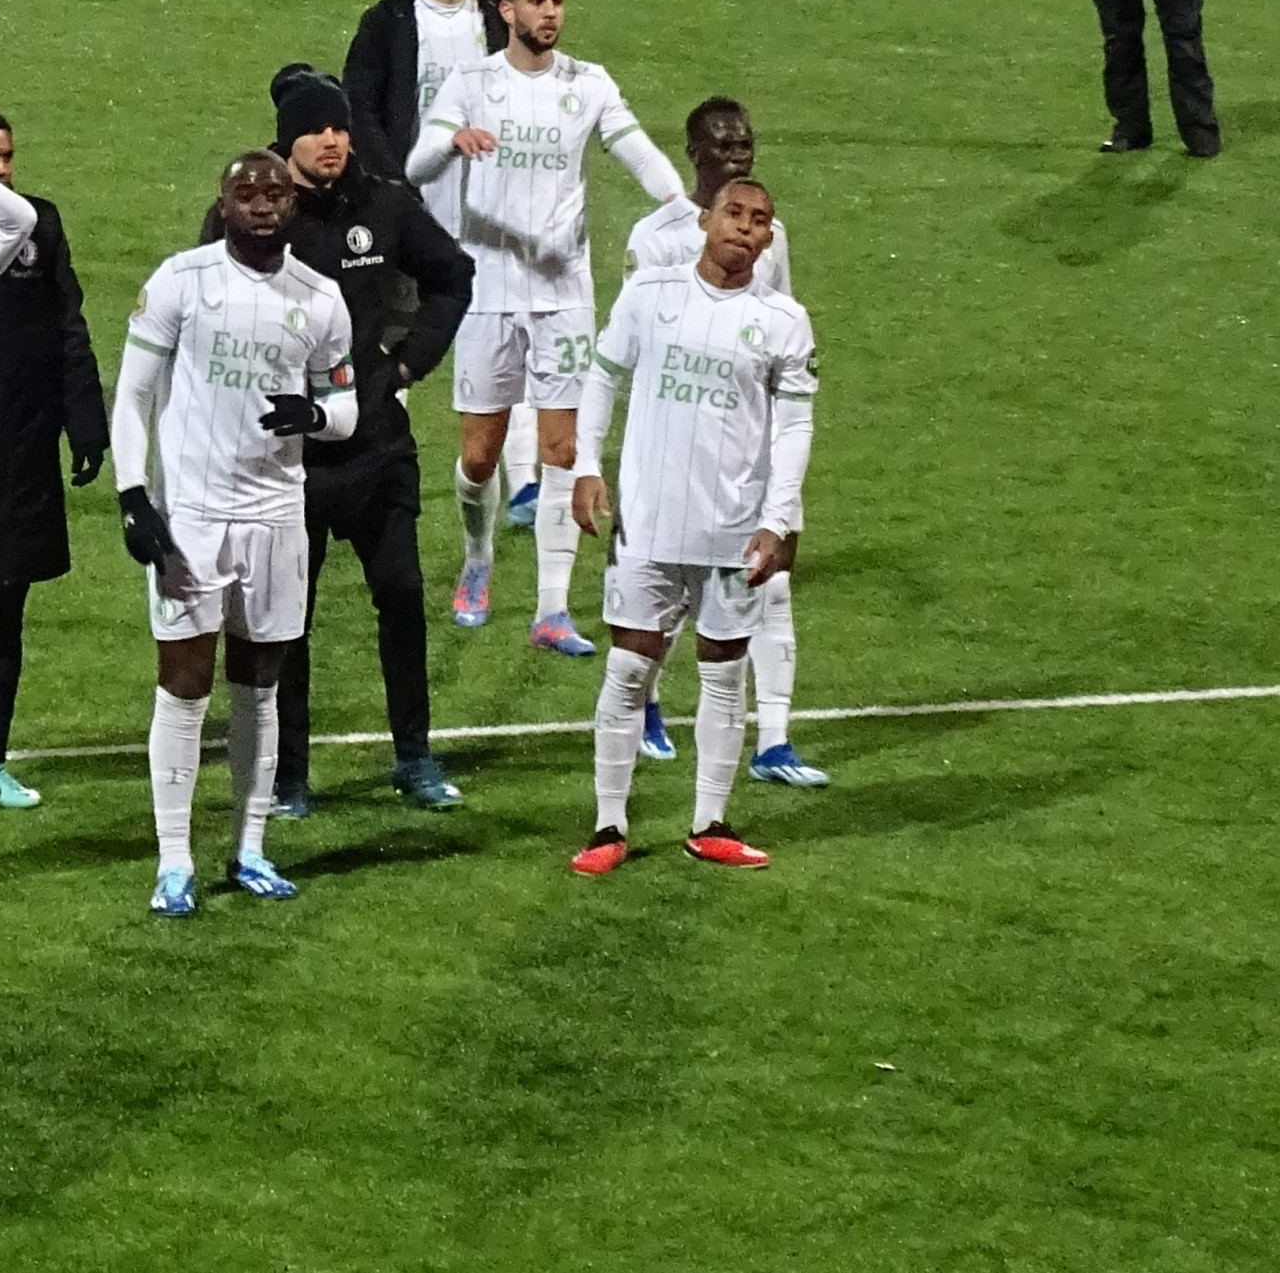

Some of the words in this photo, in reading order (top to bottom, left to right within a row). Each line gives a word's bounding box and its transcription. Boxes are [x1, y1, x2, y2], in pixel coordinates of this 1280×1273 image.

[499, 119, 561, 144] Euro
[496, 146, 569, 171] Parcs
[211, 330, 282, 364] Euro
[554, 334, 592, 374] 33
[662, 343, 734, 379] Euro
[206, 360, 284, 393] Parcs
[656, 373, 740, 410] Parcs
